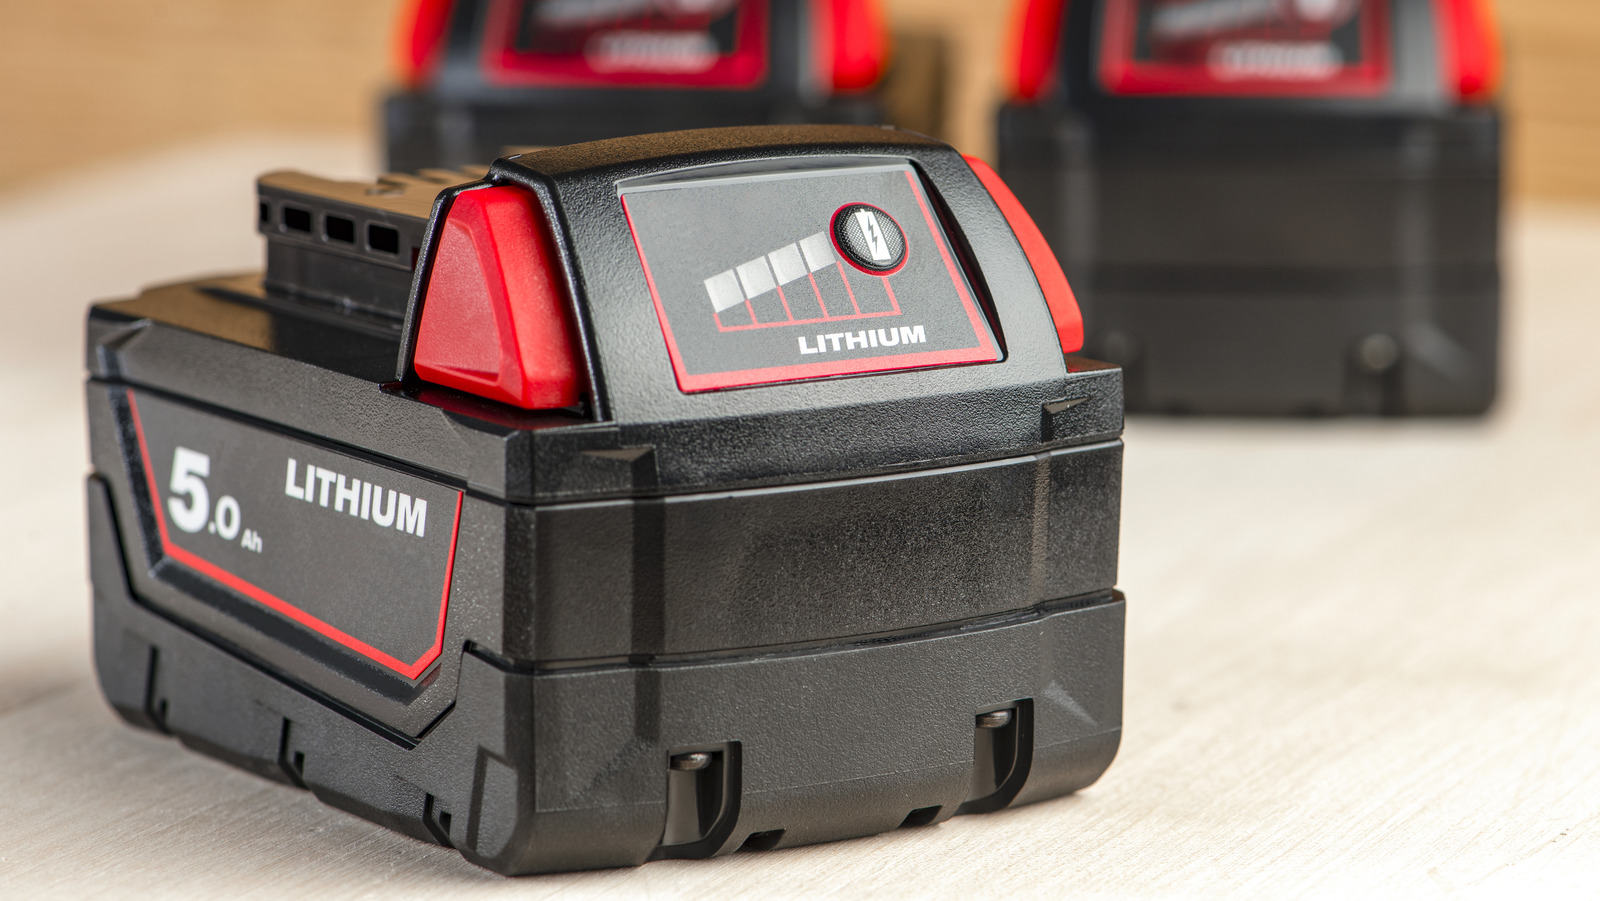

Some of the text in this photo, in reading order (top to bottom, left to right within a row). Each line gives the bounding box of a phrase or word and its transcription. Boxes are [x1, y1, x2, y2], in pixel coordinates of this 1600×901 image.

[798, 325, 927, 355] LITHIUM
[167, 446, 263, 553] 5.0 Ah
[285, 458, 428, 538] LITHIUM
